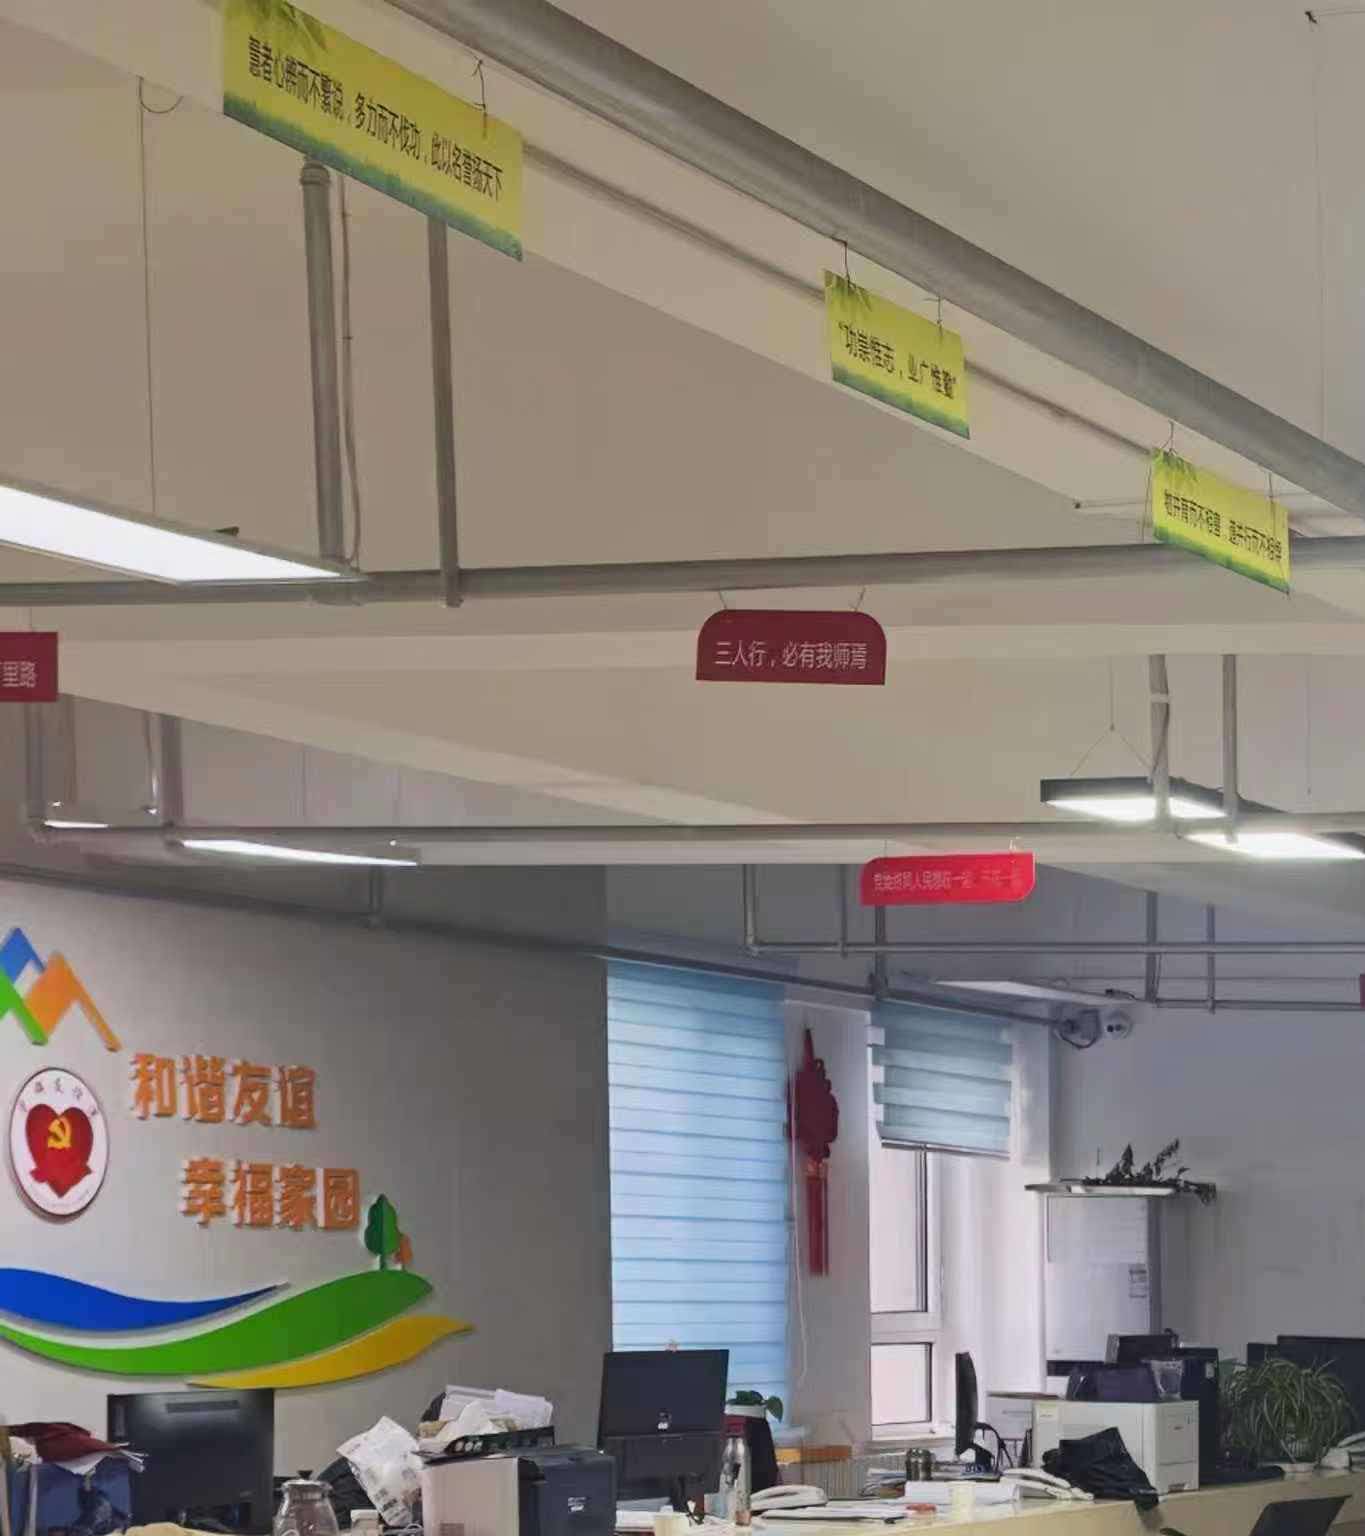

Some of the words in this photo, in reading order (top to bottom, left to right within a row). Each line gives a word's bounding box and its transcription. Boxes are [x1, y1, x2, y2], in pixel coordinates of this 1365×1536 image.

[0, 658, 37, 688] 里路
[714, 640, 868, 670] 三人行，必有我师焉
[129, 1052, 318, 1129] 和谐友谊
[180, 1156, 360, 1232] 幸福家园
